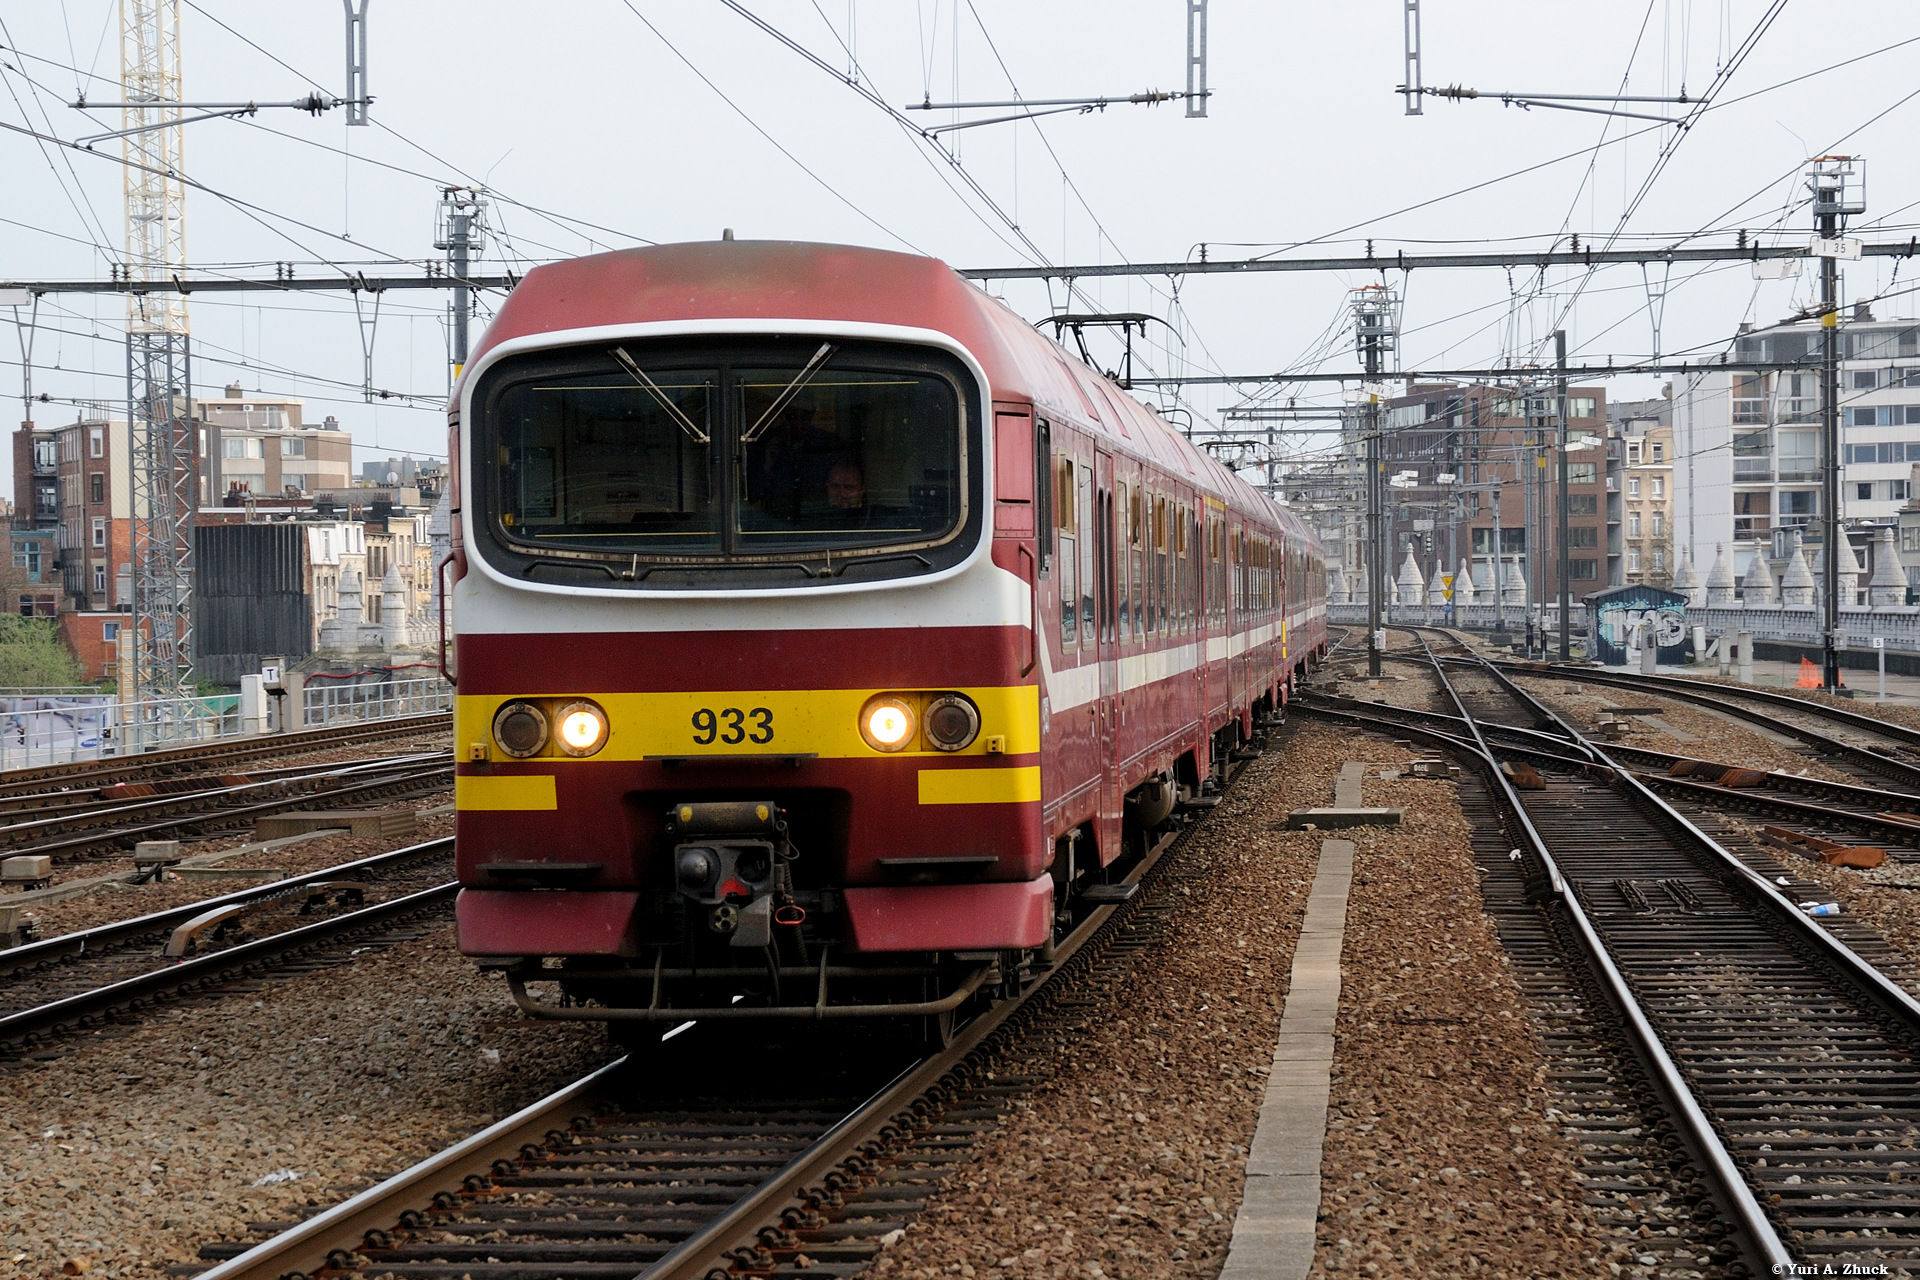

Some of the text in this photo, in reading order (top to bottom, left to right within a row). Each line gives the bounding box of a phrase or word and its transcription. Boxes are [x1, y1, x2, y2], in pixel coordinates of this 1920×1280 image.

[1834, 242, 1846, 253] 35
[266, 668, 274, 681] T
[691, 707, 774, 745] 933
